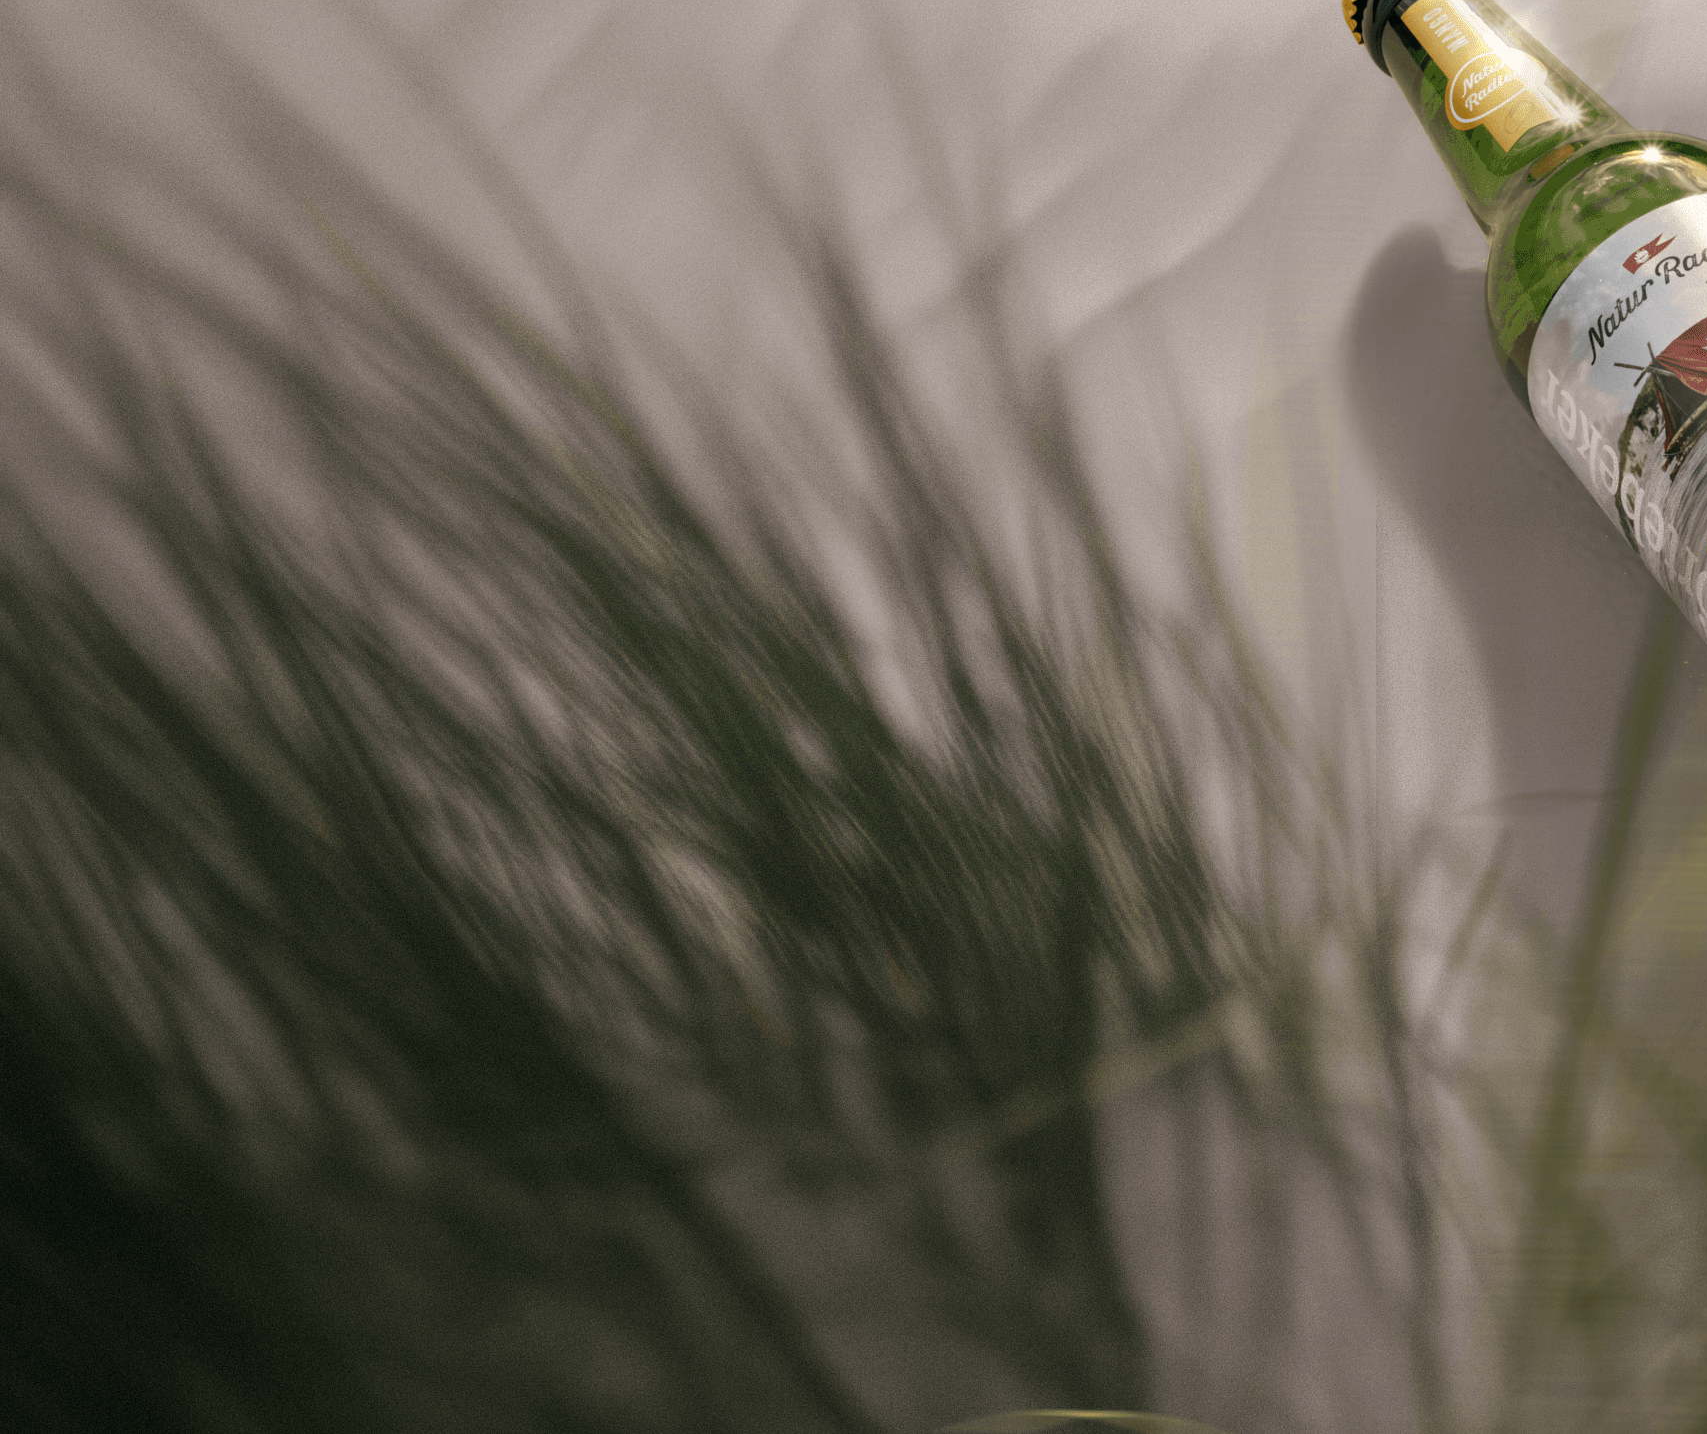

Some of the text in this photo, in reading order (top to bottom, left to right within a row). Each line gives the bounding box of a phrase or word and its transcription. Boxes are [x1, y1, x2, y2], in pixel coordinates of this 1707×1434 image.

[1422, 7, 1470, 54] MANGO
[1462, 62, 1503, 98] Natu
[1588, 279, 1654, 366] Natur
